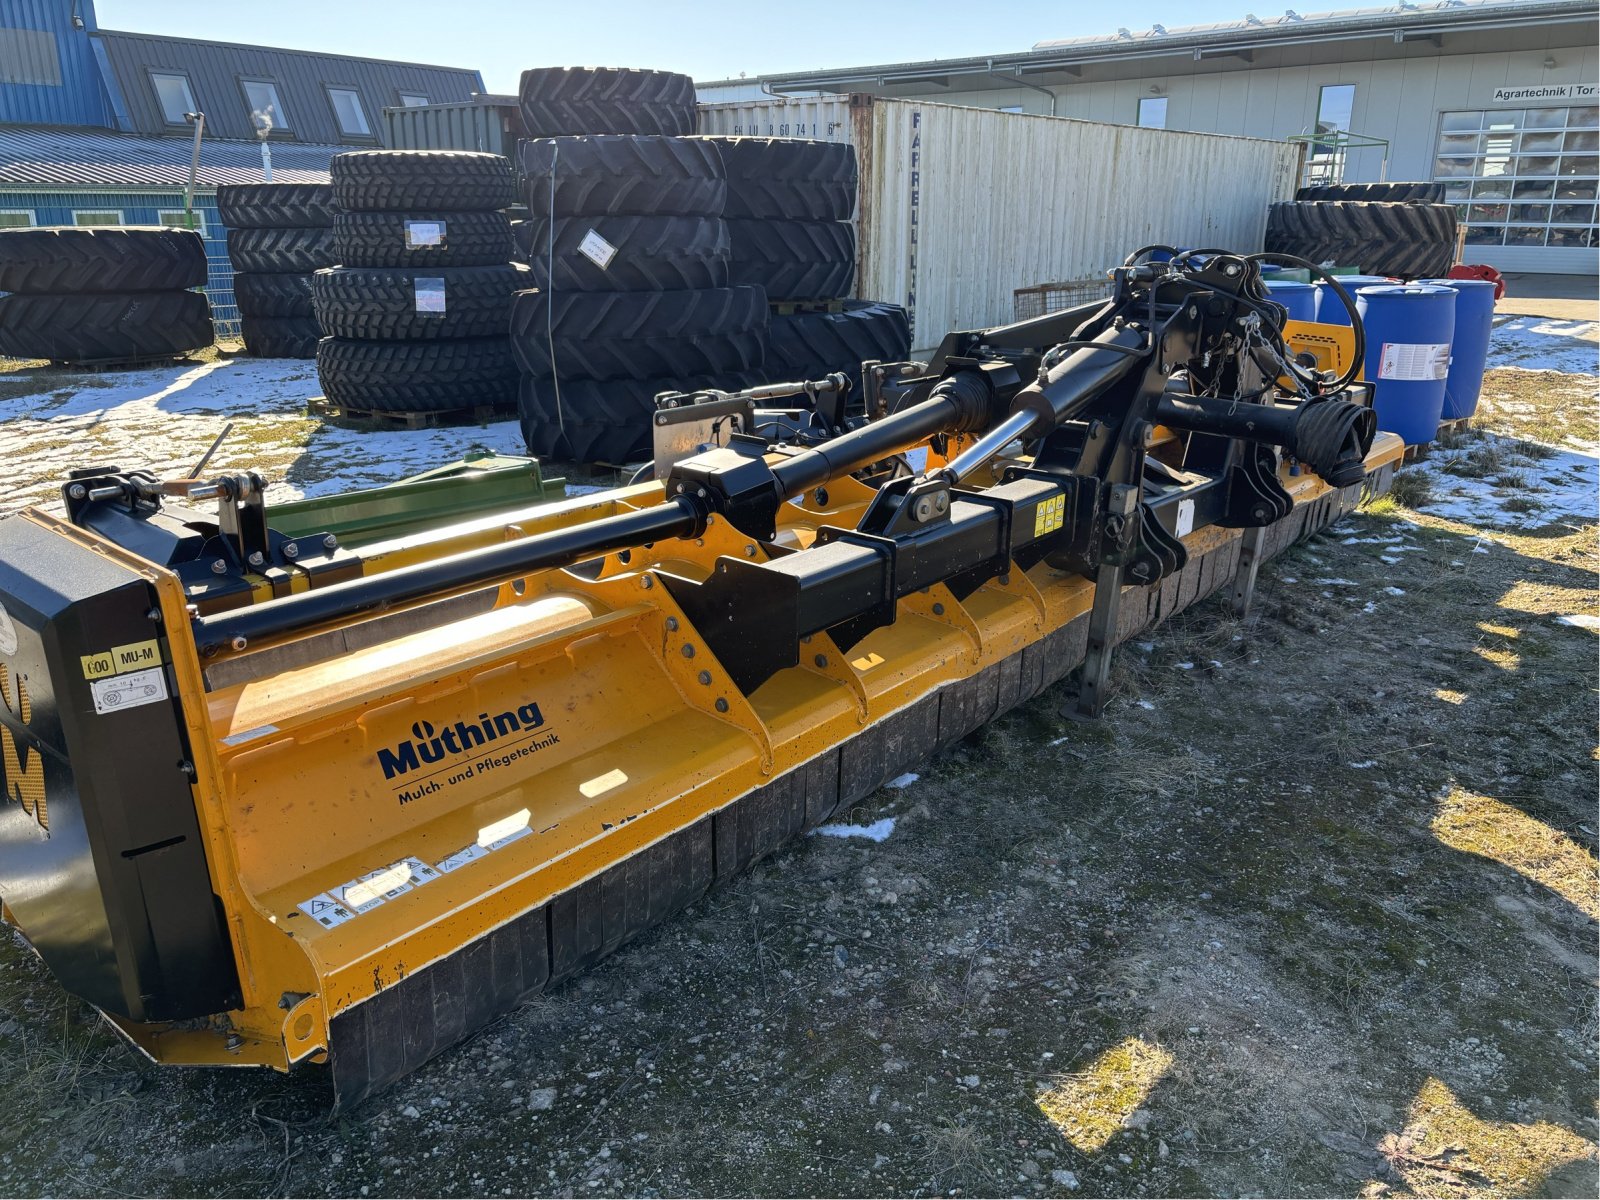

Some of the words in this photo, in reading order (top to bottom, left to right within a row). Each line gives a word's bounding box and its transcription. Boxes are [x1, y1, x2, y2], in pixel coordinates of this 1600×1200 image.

[1495, 86, 1567, 100] Agrartechnik
[1576, 85, 1595, 96] Tor
[121, 647, 154, 665] MU-M
[87, 659, 109, 674] 600
[376, 702, 545, 780] Müthing
[398, 780, 445, 806] Mulch-
[447, 766, 475, 786] und
[476, 733, 561, 775] Pflegetechnik
